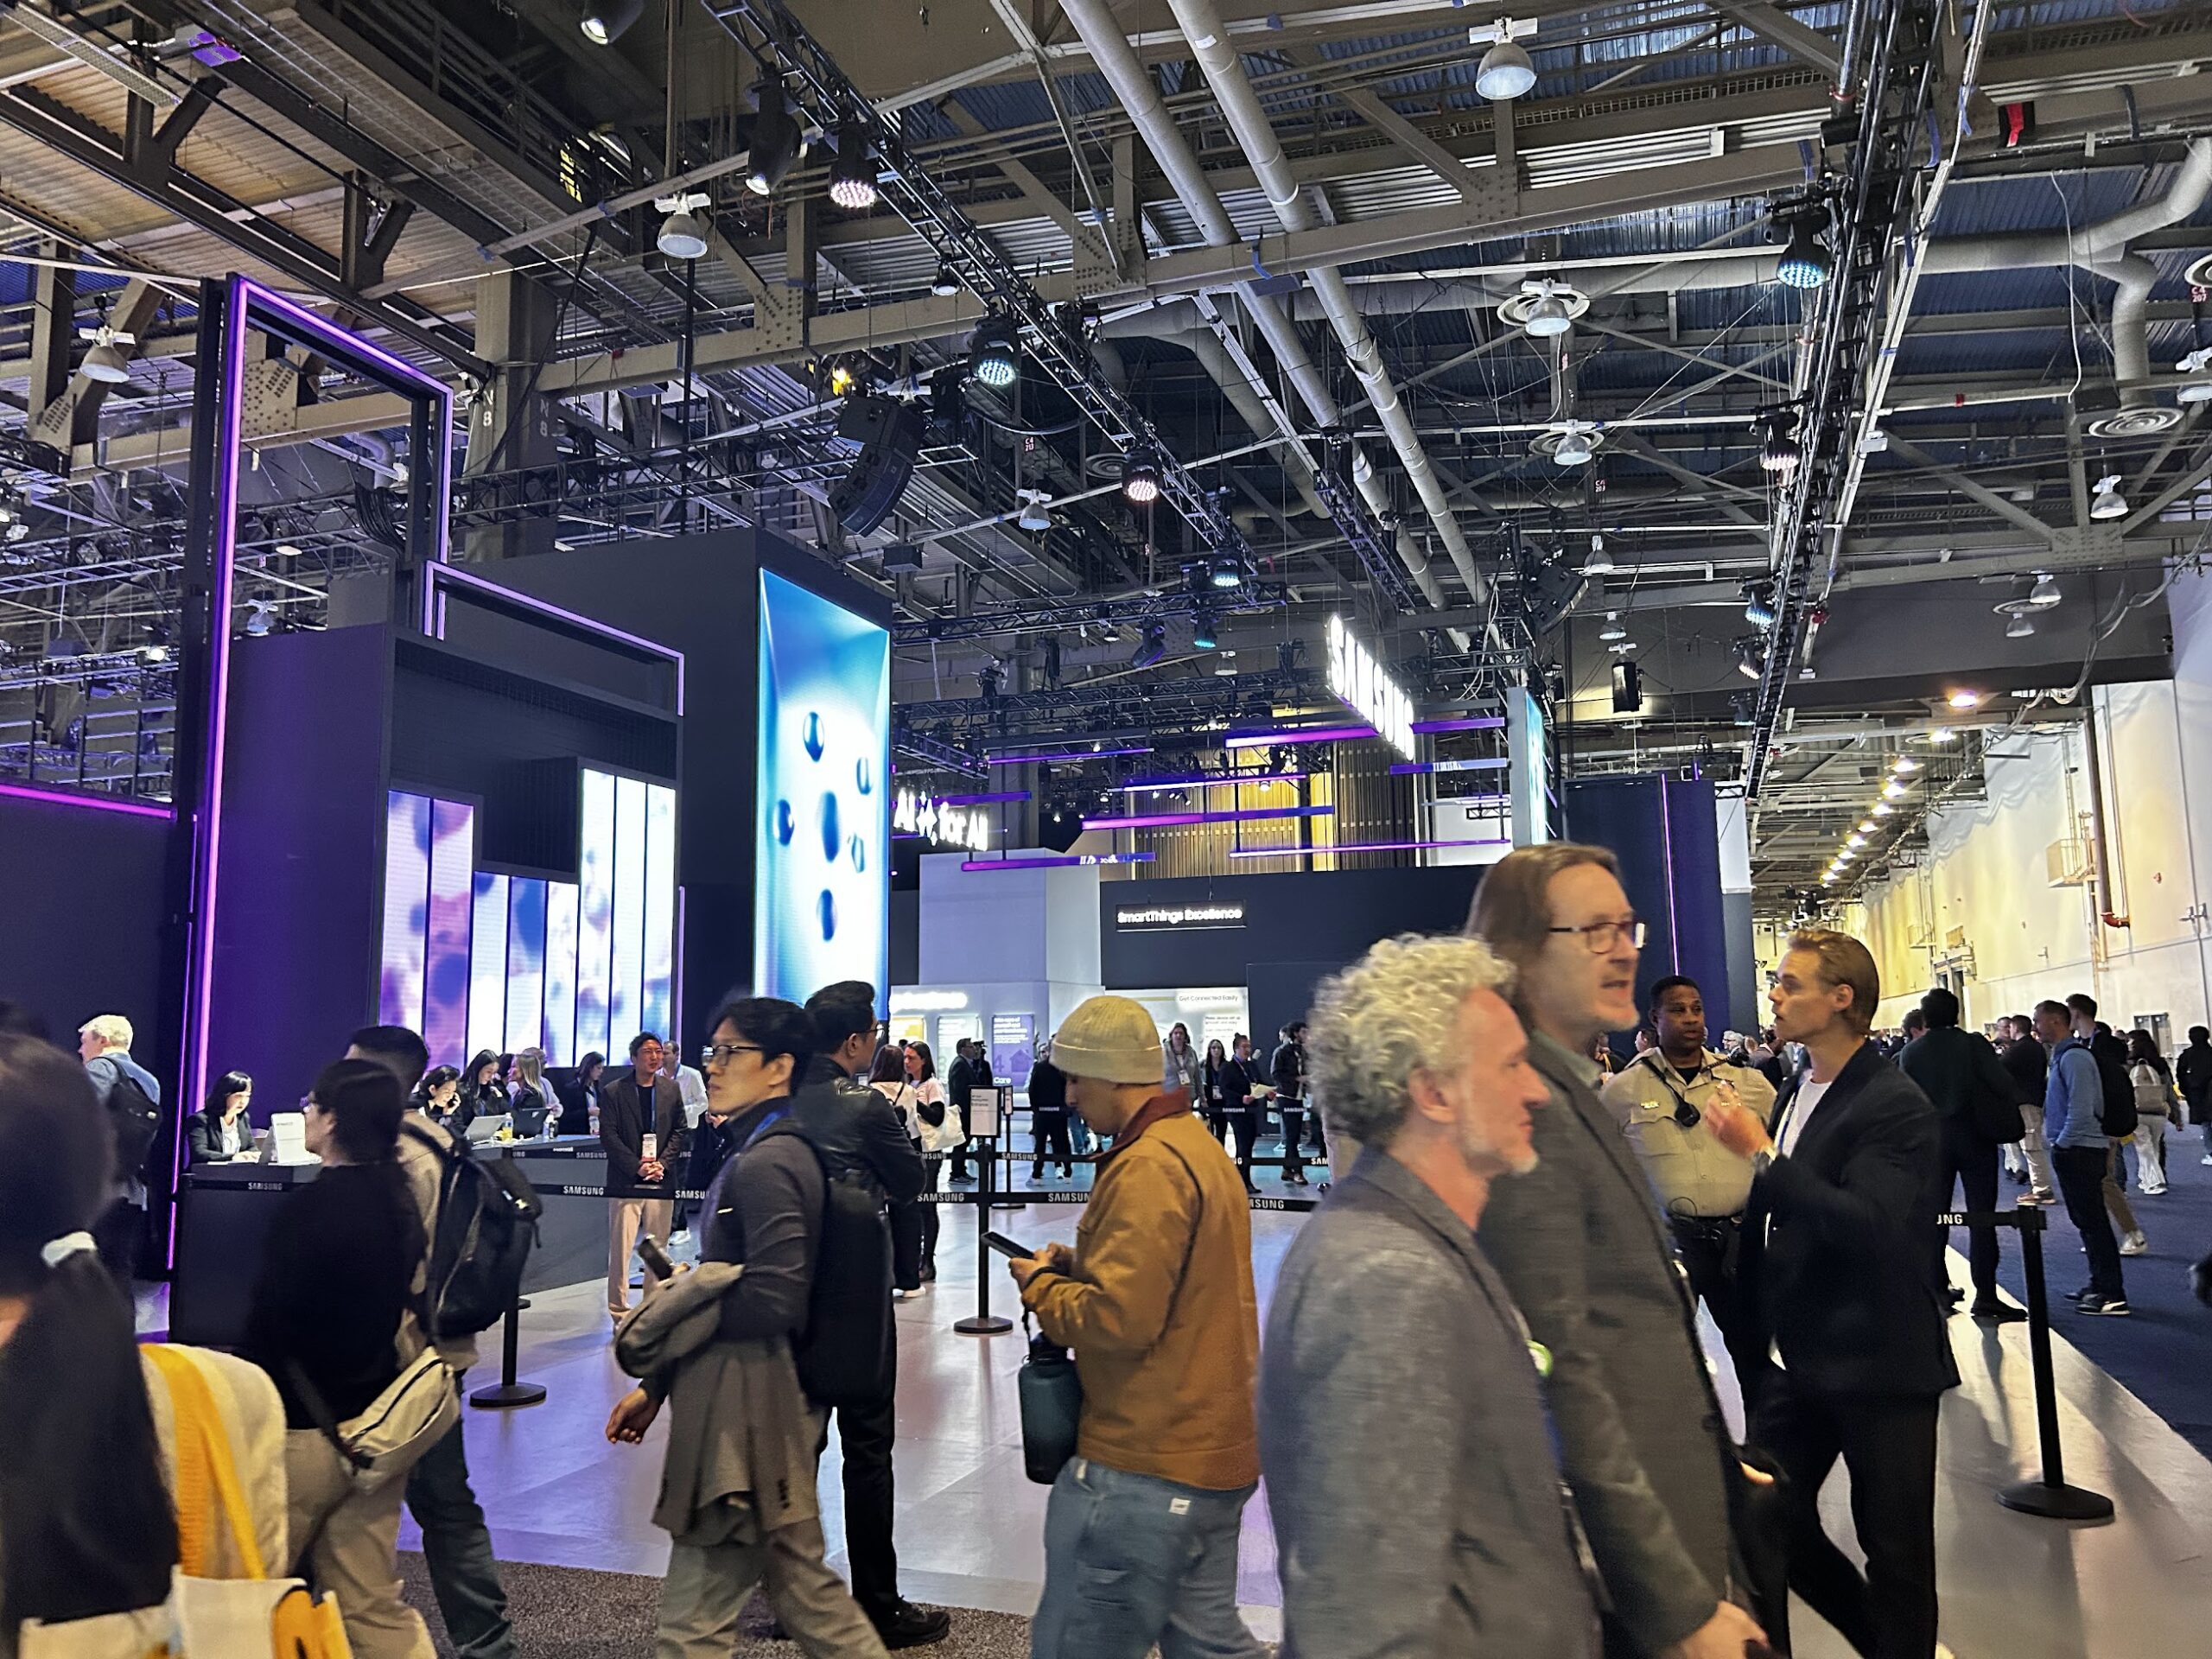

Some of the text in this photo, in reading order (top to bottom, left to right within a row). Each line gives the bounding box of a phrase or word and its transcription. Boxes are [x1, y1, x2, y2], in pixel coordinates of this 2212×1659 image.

[484, 390, 493, 405] N
[483, 410, 492, 427] 8
[540, 421, 548, 436] 8
[1001, 679, 1008, 690] 7
[1117, 908, 1243, 925] SmartThings Excellence
[993, 1054, 1005, 1072] 4
[994, 1076, 1012, 1084] Care
[248, 1182, 283, 1191] SAMSUNG
[563, 1185, 604, 1196] SAMSUNG
[675, 1190, 710, 1199] SAMSU
[918, 1192, 965, 1202] SAMSUNG
[1048, 1192, 1090, 1202] SAMSUN
